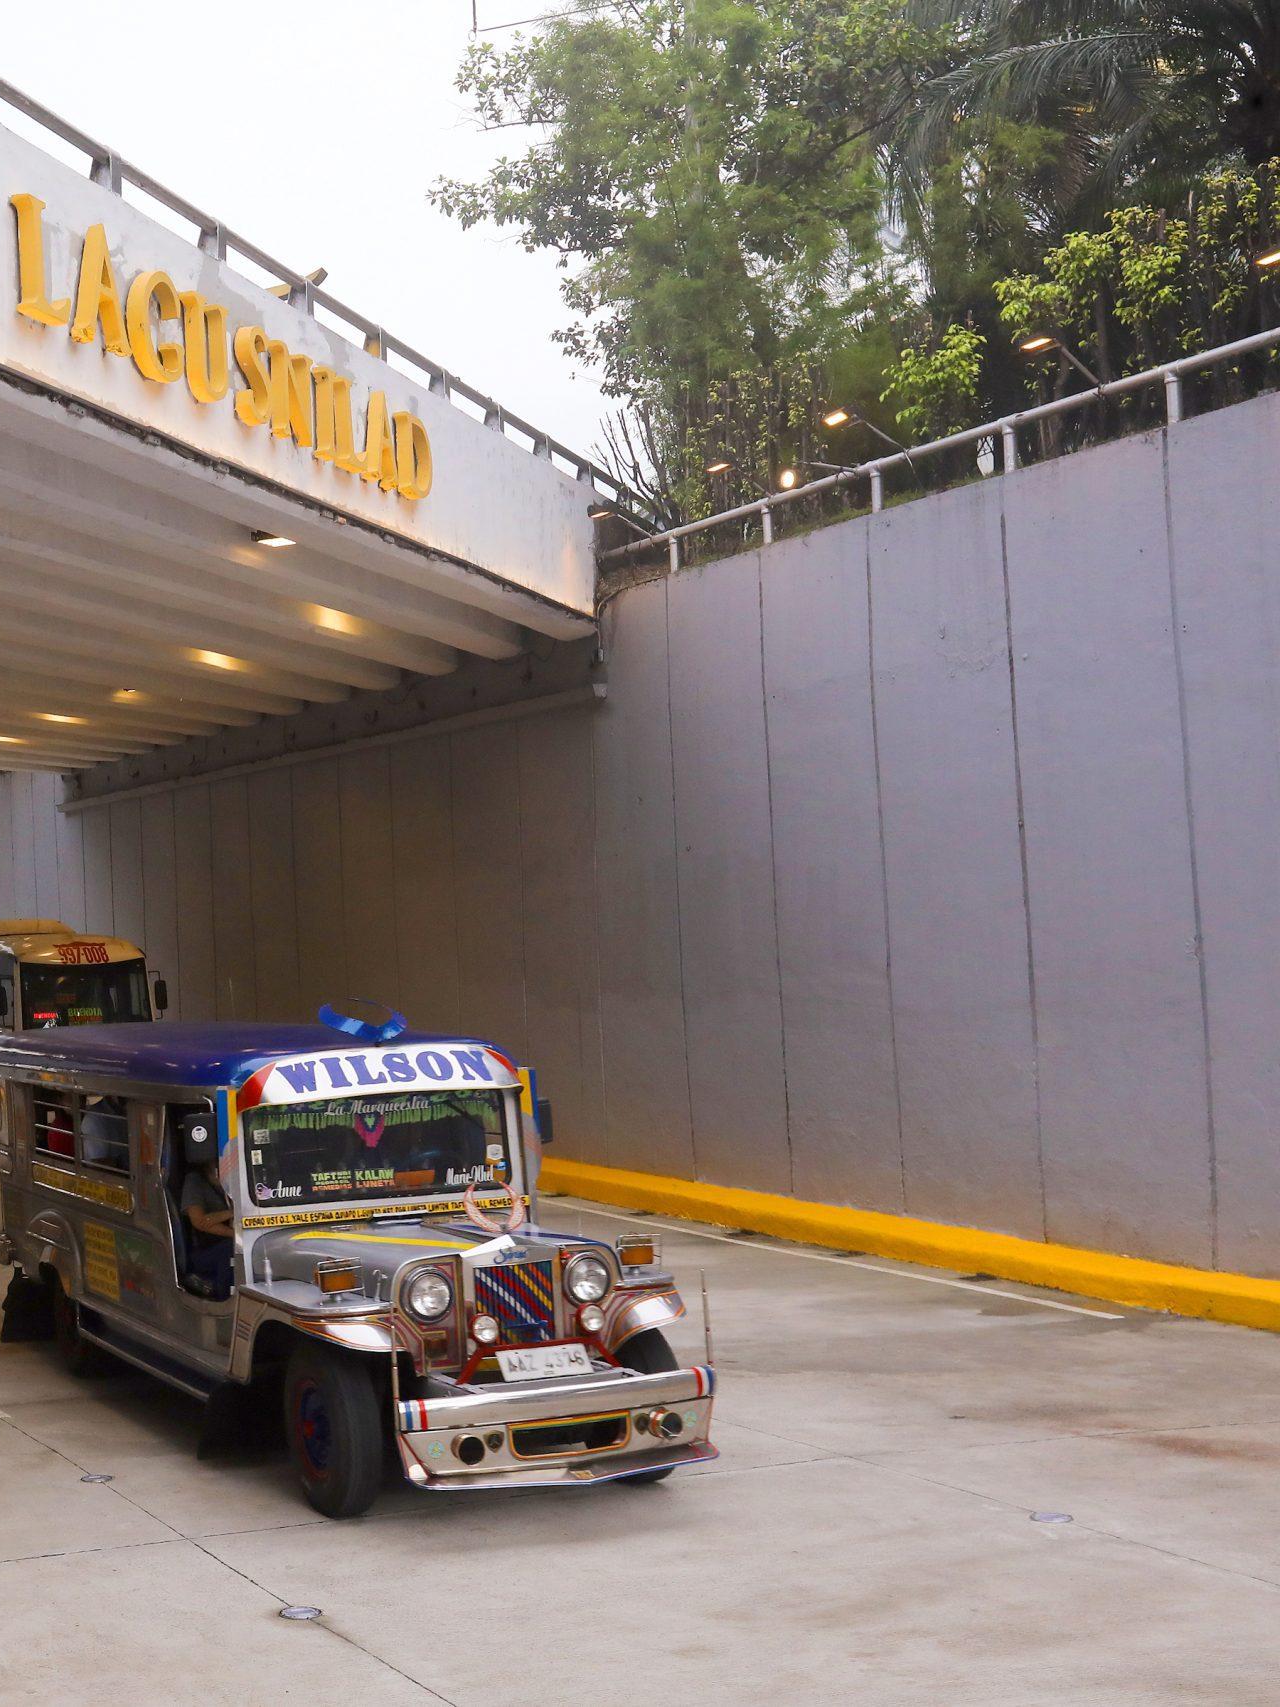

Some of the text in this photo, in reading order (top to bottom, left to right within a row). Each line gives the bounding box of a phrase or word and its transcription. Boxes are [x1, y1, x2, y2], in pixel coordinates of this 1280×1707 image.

[10, 192, 433, 499] LAGUSNILAD
[275, 1050, 494, 1094] WILSON
[311, 1171, 337, 1182] TAFT
[355, 1168, 394, 1181] KALAW
[270, 1180, 302, 1199] Anne
[356, 1180, 395, 1188] LUNETA
